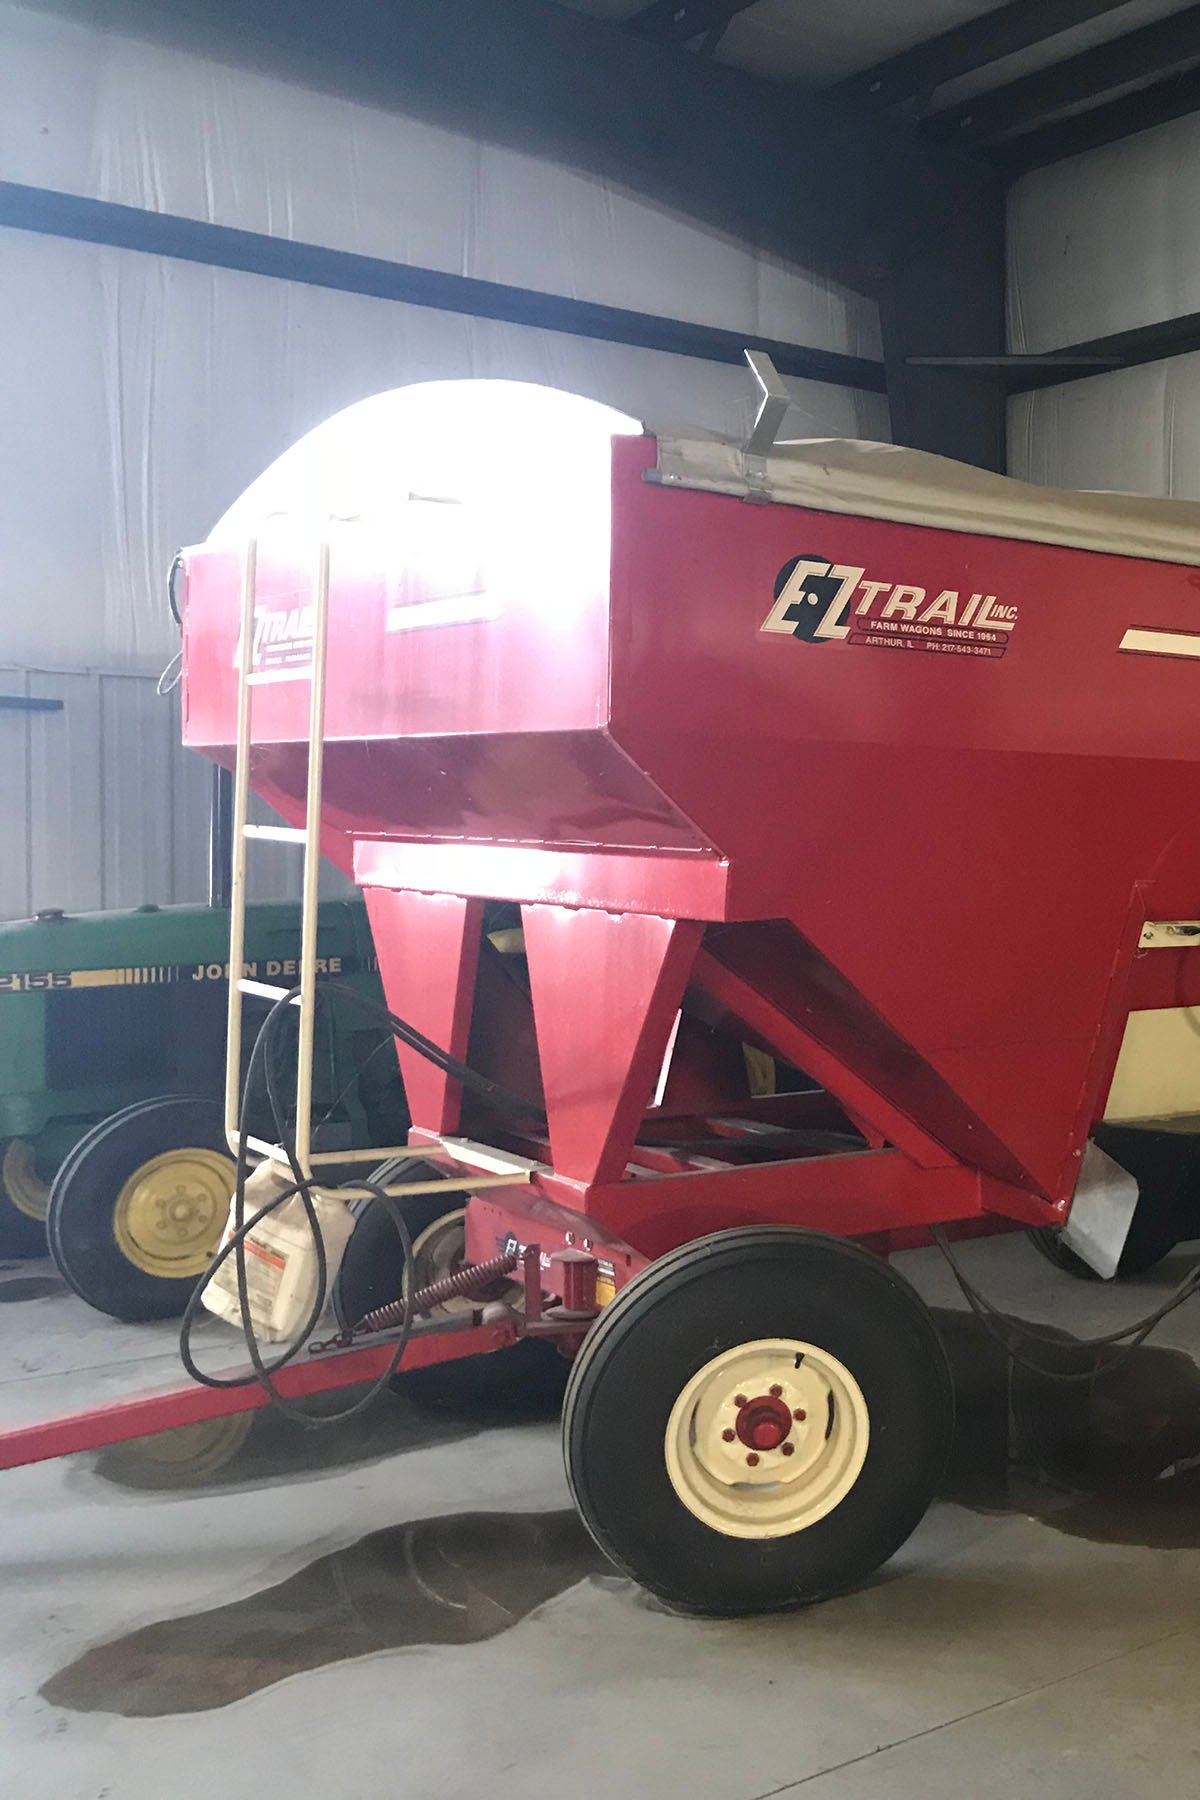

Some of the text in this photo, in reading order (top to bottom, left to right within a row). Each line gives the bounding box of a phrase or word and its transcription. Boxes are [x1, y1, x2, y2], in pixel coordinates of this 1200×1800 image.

[855, 580, 1016, 631] TRAIL
[990, 604, 1019, 620] INC.
[870, 620, 898, 631] FARM
[900, 623, 942, 636] WAGONS
[947, 628, 975, 639] SINCE
[191, 957, 342, 981] JON DERE
